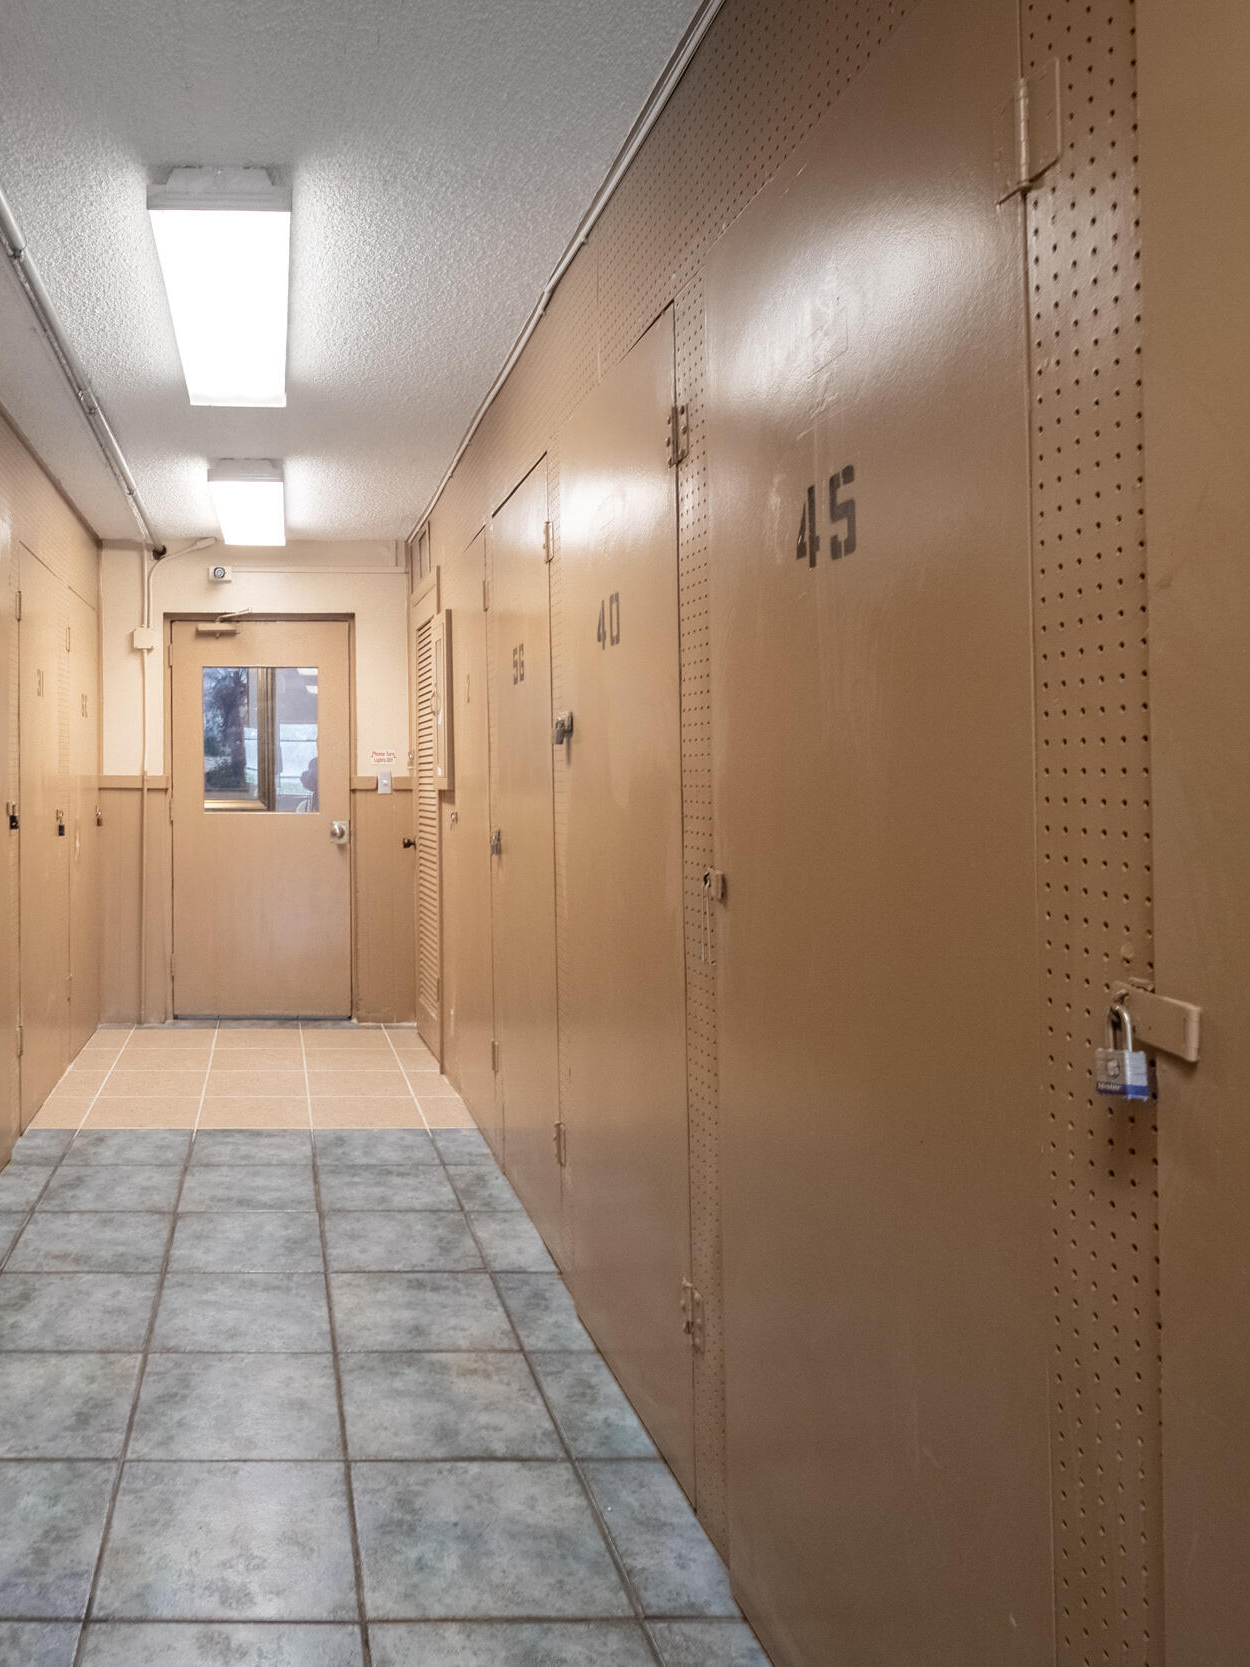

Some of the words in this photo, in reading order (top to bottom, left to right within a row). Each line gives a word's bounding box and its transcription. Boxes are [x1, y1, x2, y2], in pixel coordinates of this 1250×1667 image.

[796, 465, 856, 568] 45
[597, 592, 620, 650] 40
[513, 643, 524, 685] 56
